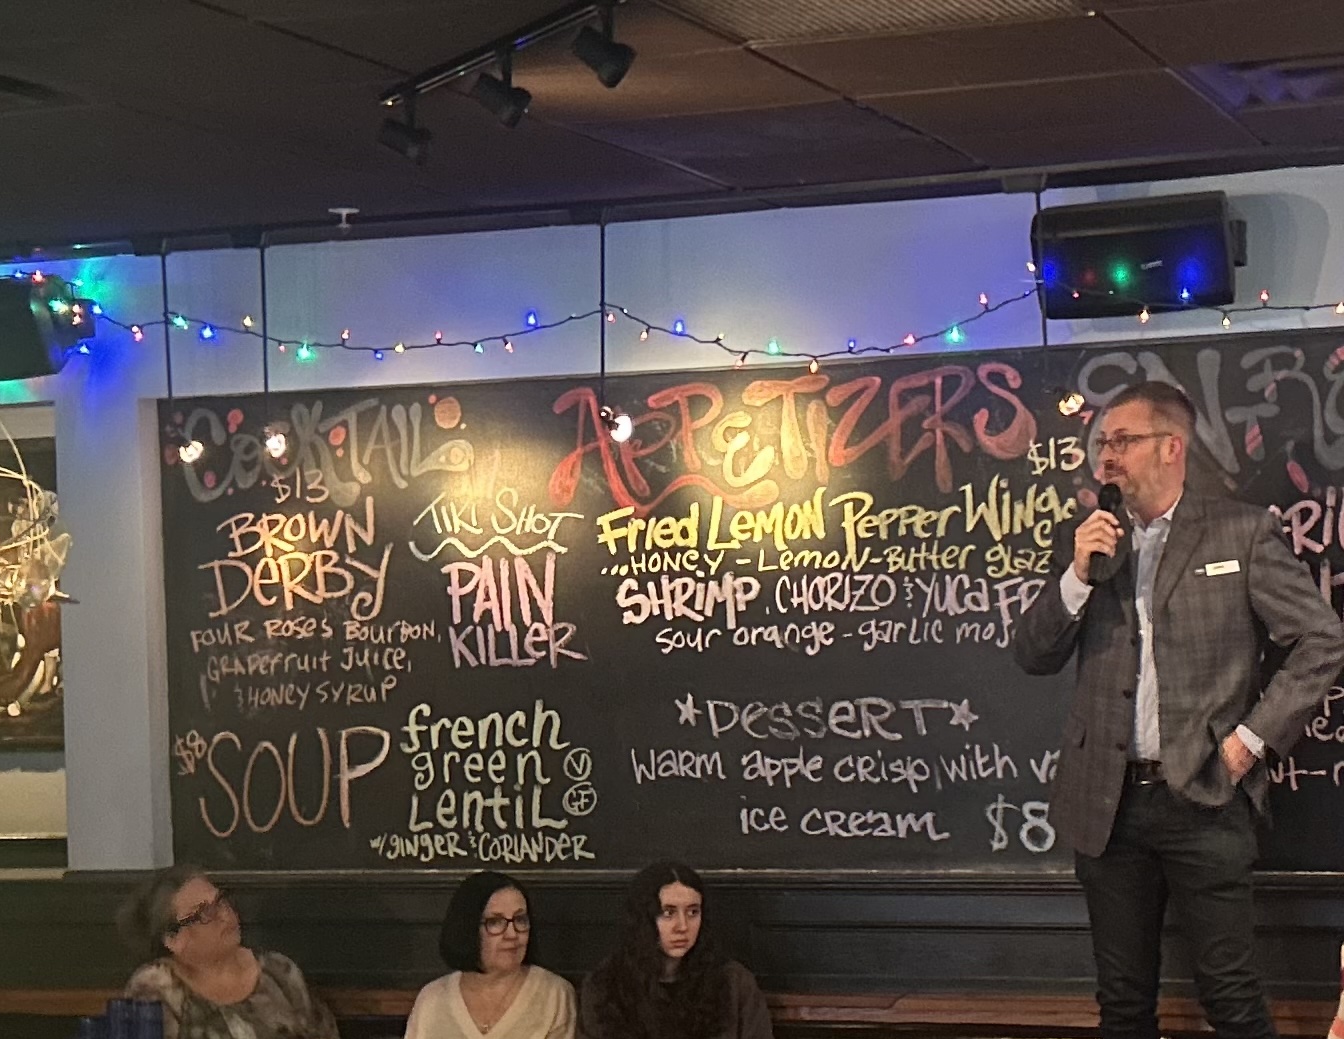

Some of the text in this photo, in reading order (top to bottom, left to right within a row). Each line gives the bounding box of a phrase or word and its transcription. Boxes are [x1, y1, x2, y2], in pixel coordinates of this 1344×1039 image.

[1027, 437, 1086, 475] $13
[270, 468, 329, 504] $13
[216, 496, 375, 558] BROWN
[441, 551, 556, 632] PAIN
[400, 699, 571, 753] french
[199, 726, 391, 838] SOUP
[411, 750, 551, 790] green
[741, 745, 824, 788] apple
[939, 742, 1018, 783] with
[985, 793, 1056, 853] $8
